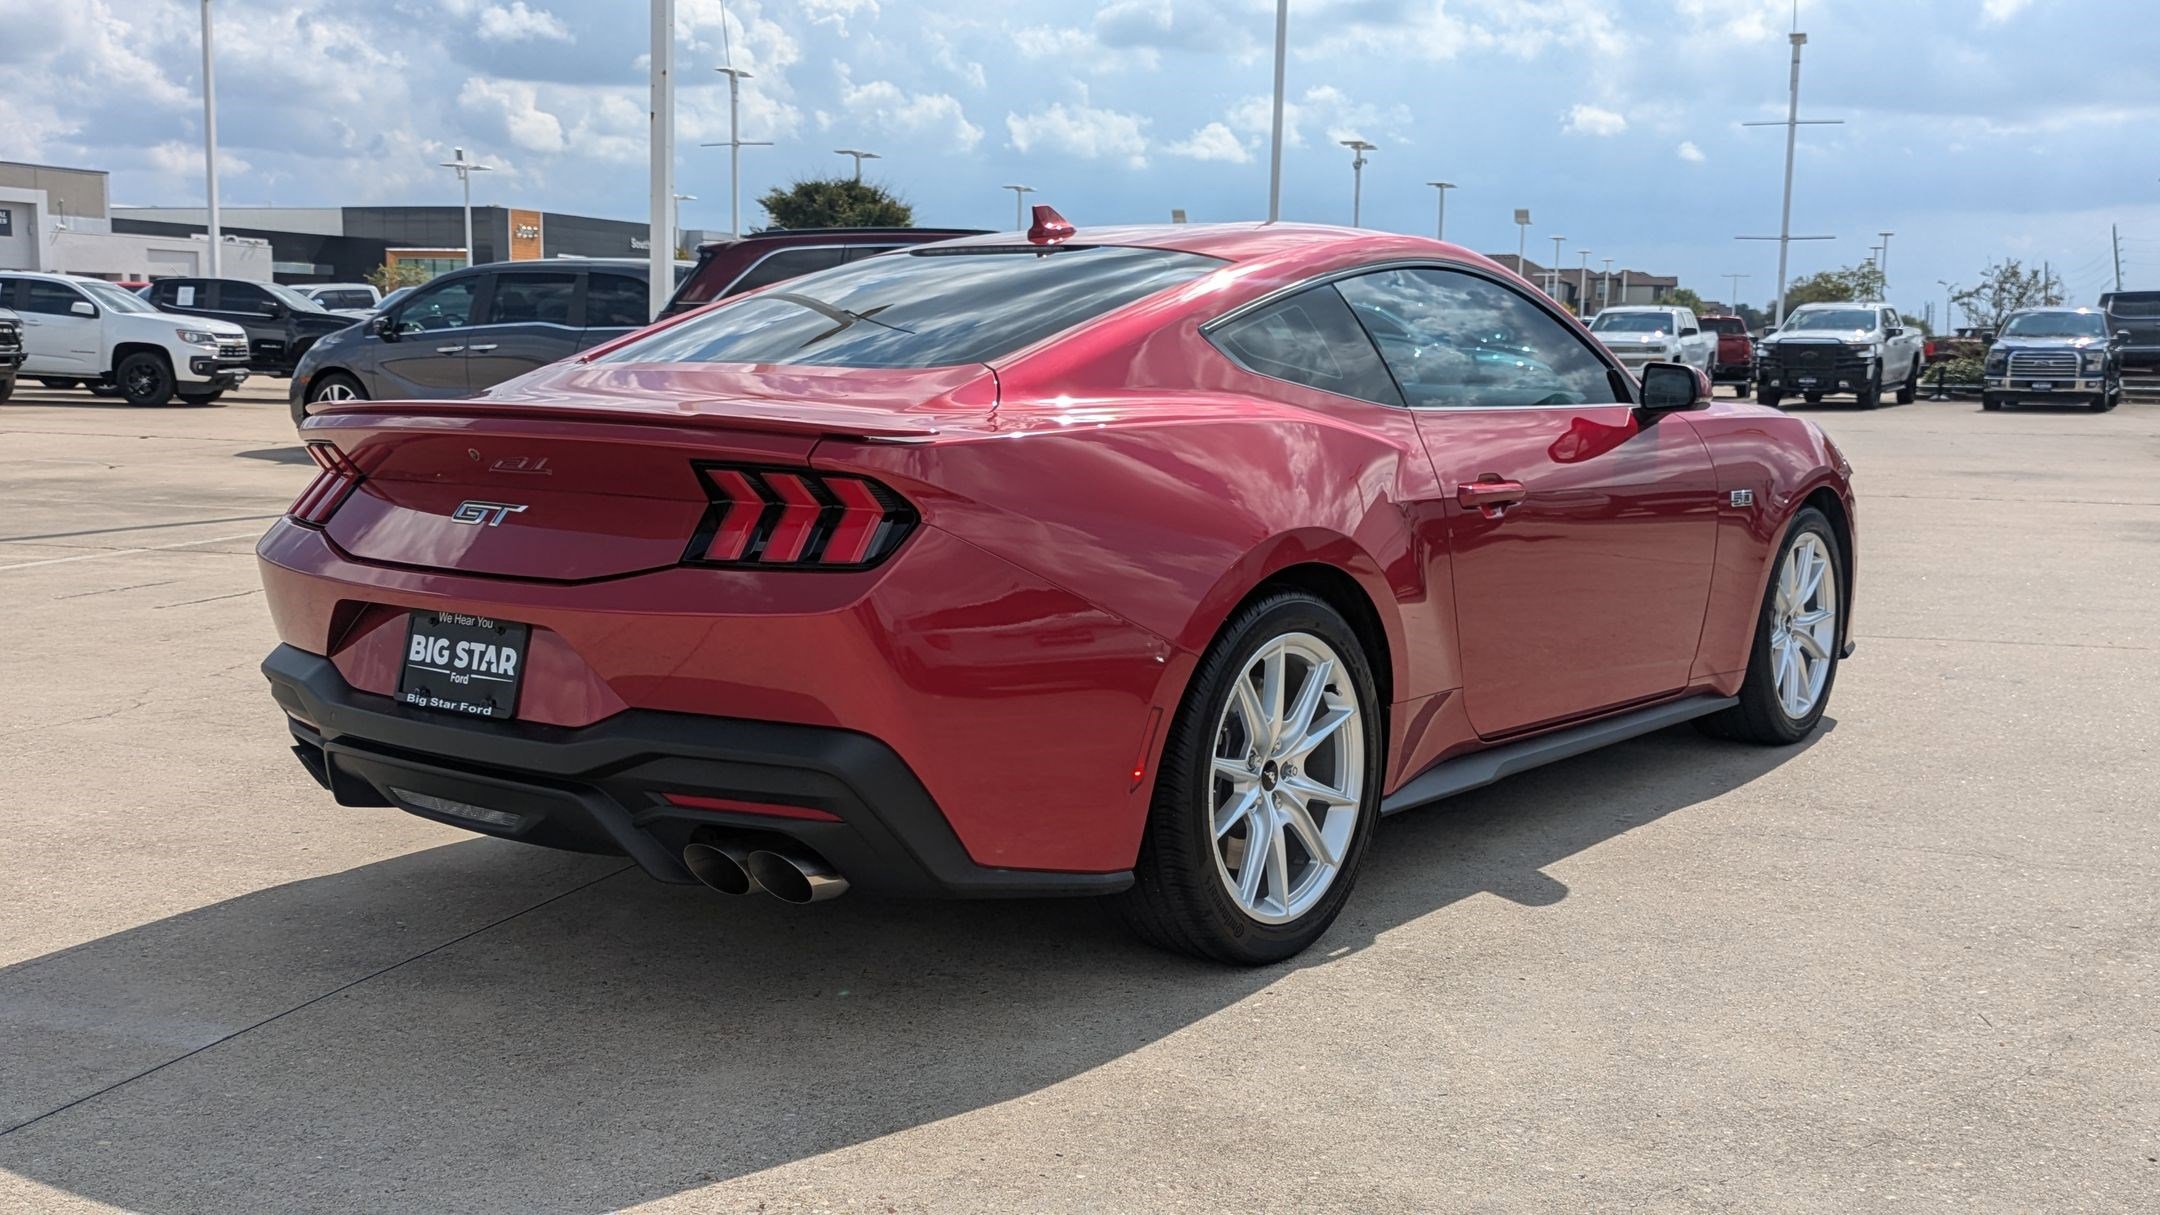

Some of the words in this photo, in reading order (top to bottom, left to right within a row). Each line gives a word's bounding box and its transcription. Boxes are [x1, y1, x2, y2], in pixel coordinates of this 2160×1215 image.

[451, 499, 529, 527] GT
[439, 612, 452, 623] We
[454, 613, 475, 626] Hear
[477, 616, 494, 629] You
[409, 634, 450, 665] BIG
[453, 641, 517, 676] STAR
[450, 672, 469, 685] Ford
[406, 693, 427, 706] Big
[430, 697, 457, 710] Star
[460, 702, 492, 715] Ford
